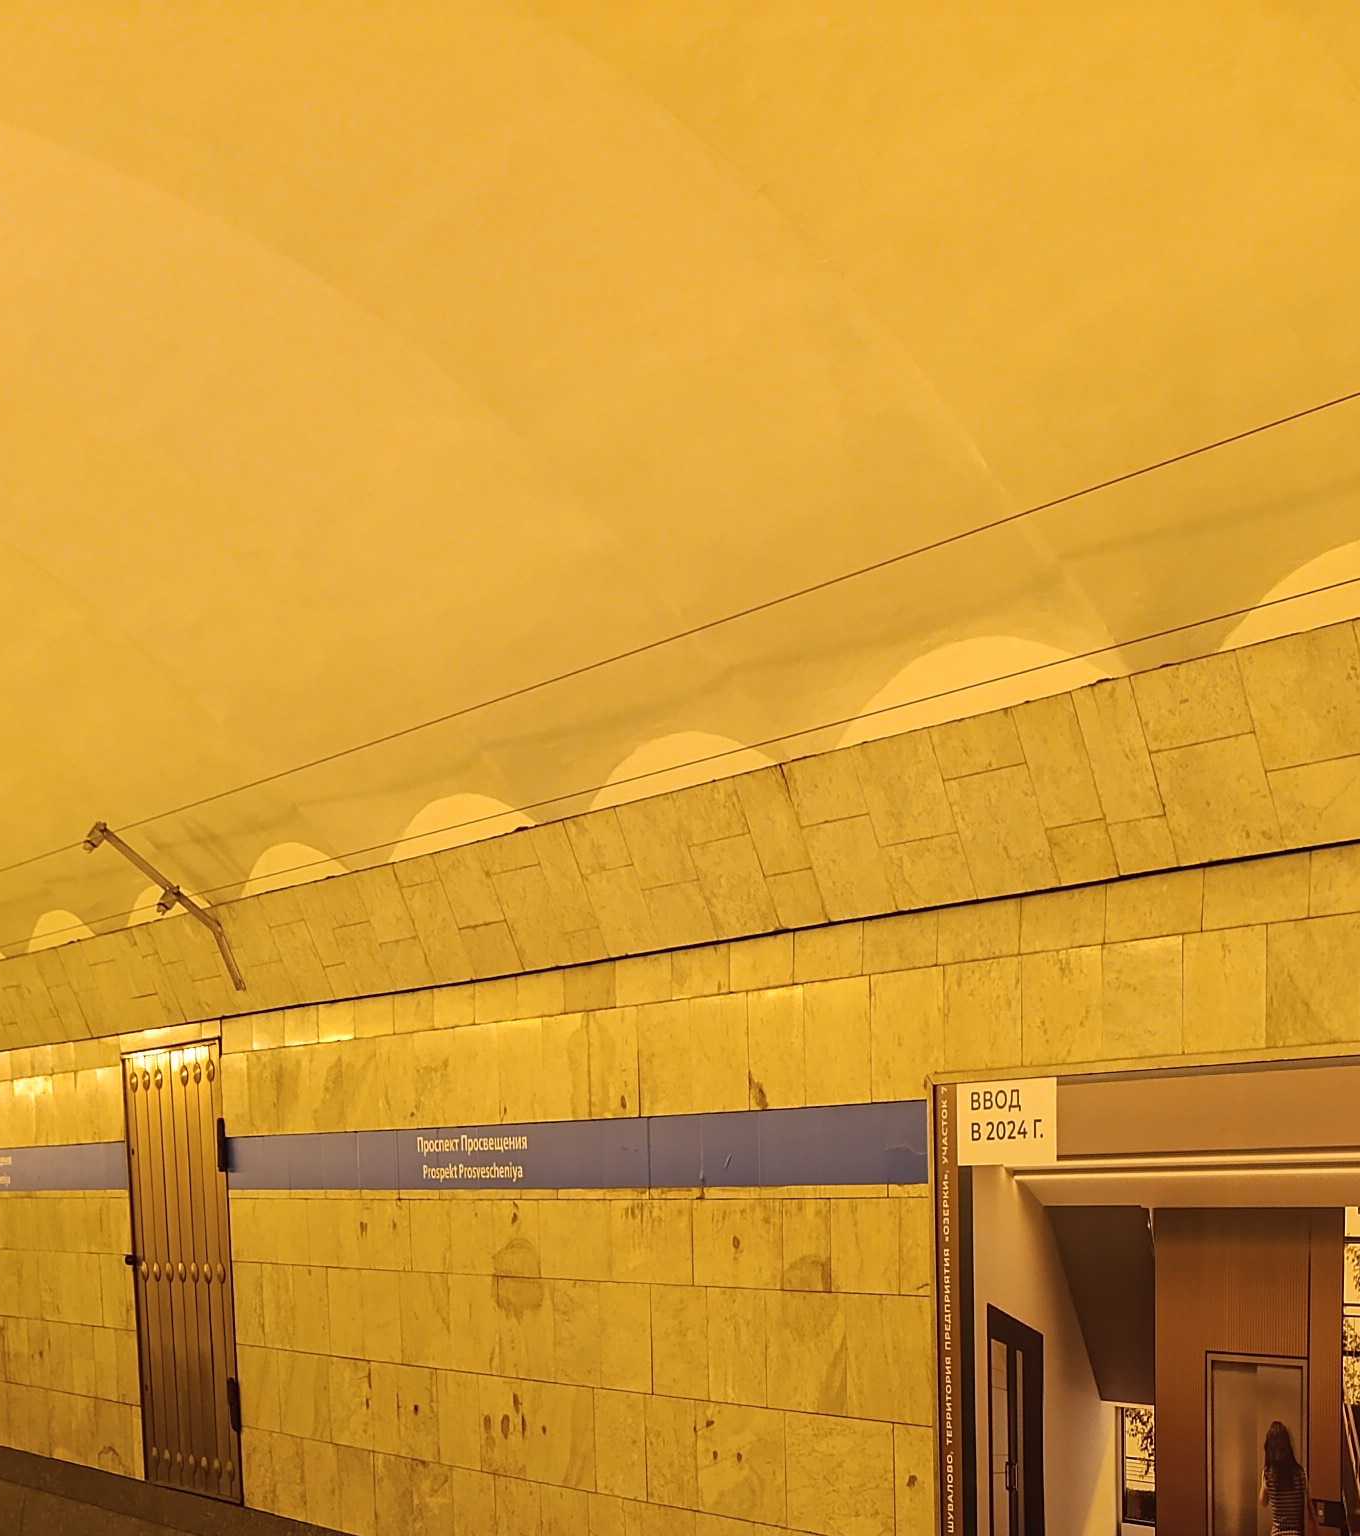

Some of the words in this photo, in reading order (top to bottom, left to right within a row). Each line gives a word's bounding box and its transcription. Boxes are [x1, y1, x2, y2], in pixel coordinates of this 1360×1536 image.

[970, 1089, 1022, 1112] ВВОД
[941, 1100, 949, 1165] УЧАСТОК
[971, 1122, 981, 1141] В
[986, 1120, 1028, 1141] 2024
[1034, 1119, 1044, 1139] Г.
[416, 1136, 459, 1156] Проспект
[461, 1134, 528, 1156] Просвещения
[423, 1163, 458, 1182] Prospekt
[459, 1162, 523, 1182] Prosvescheniya
[943, 1248, 952, 1350] ПРЕДПРИЯТИЯ
[944, 1356, 953, 1446] ТЕРРИТОРИЯ
